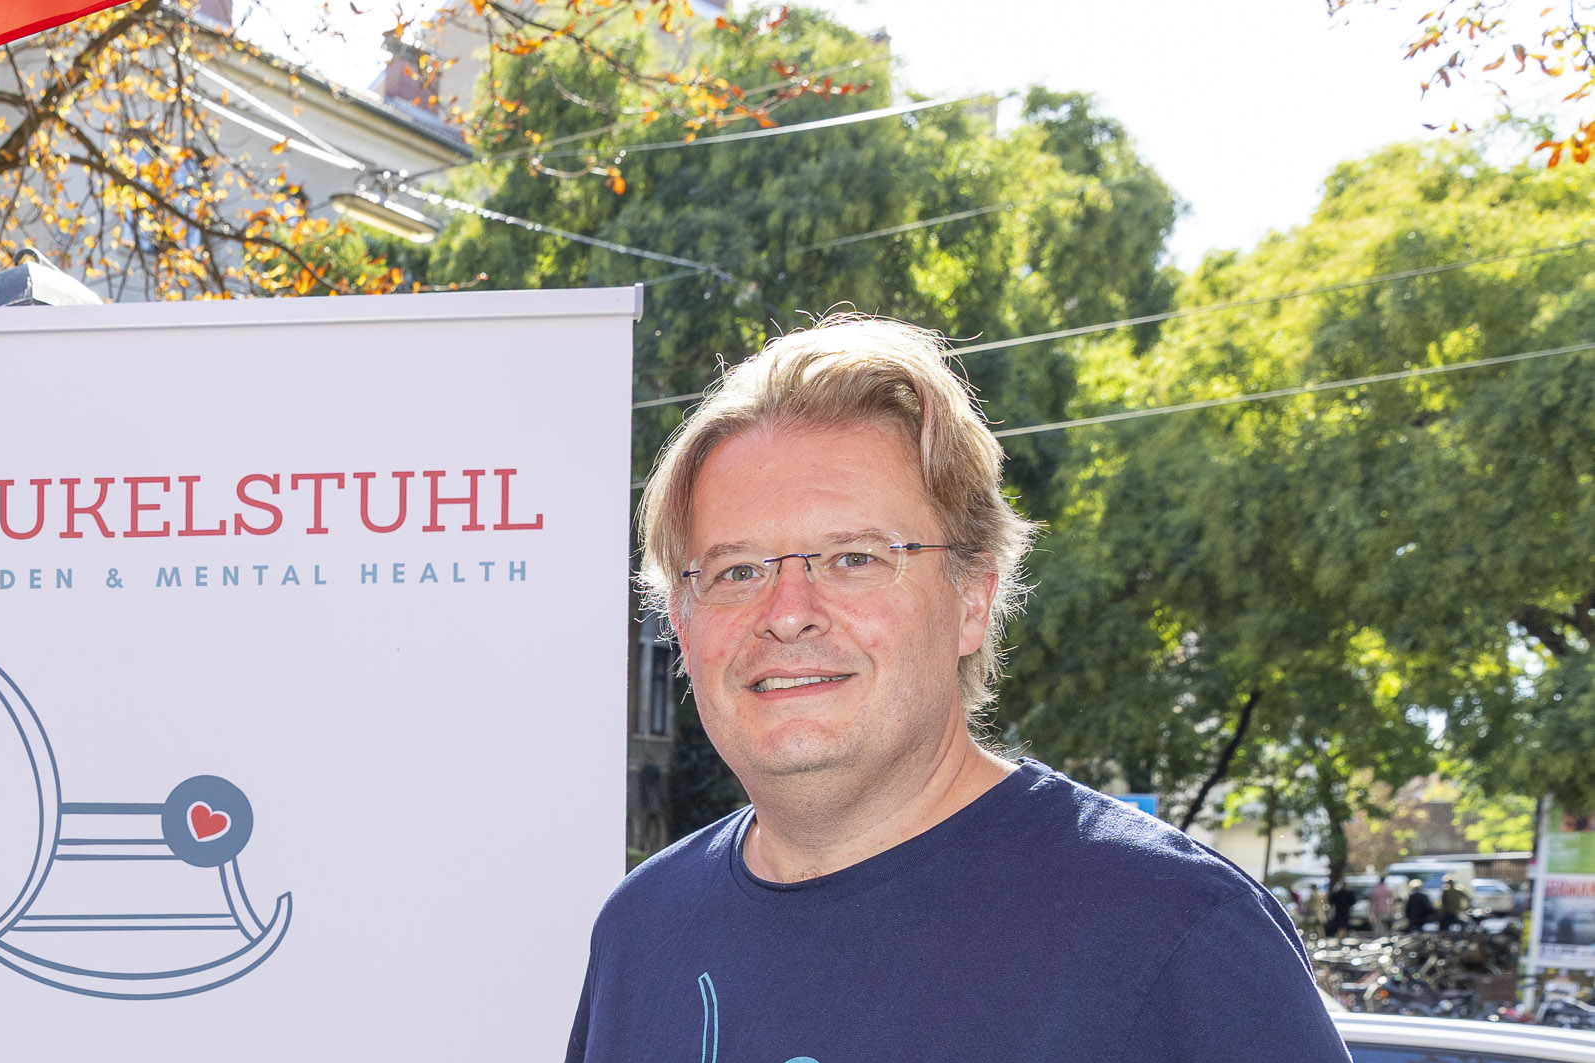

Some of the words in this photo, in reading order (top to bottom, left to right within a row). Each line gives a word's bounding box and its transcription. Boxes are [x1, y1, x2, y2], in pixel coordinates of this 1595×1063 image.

[106, 568, 123, 588] &
[156, 565, 326, 587] MENTAL
[361, 561, 525, 584] HEALTH
